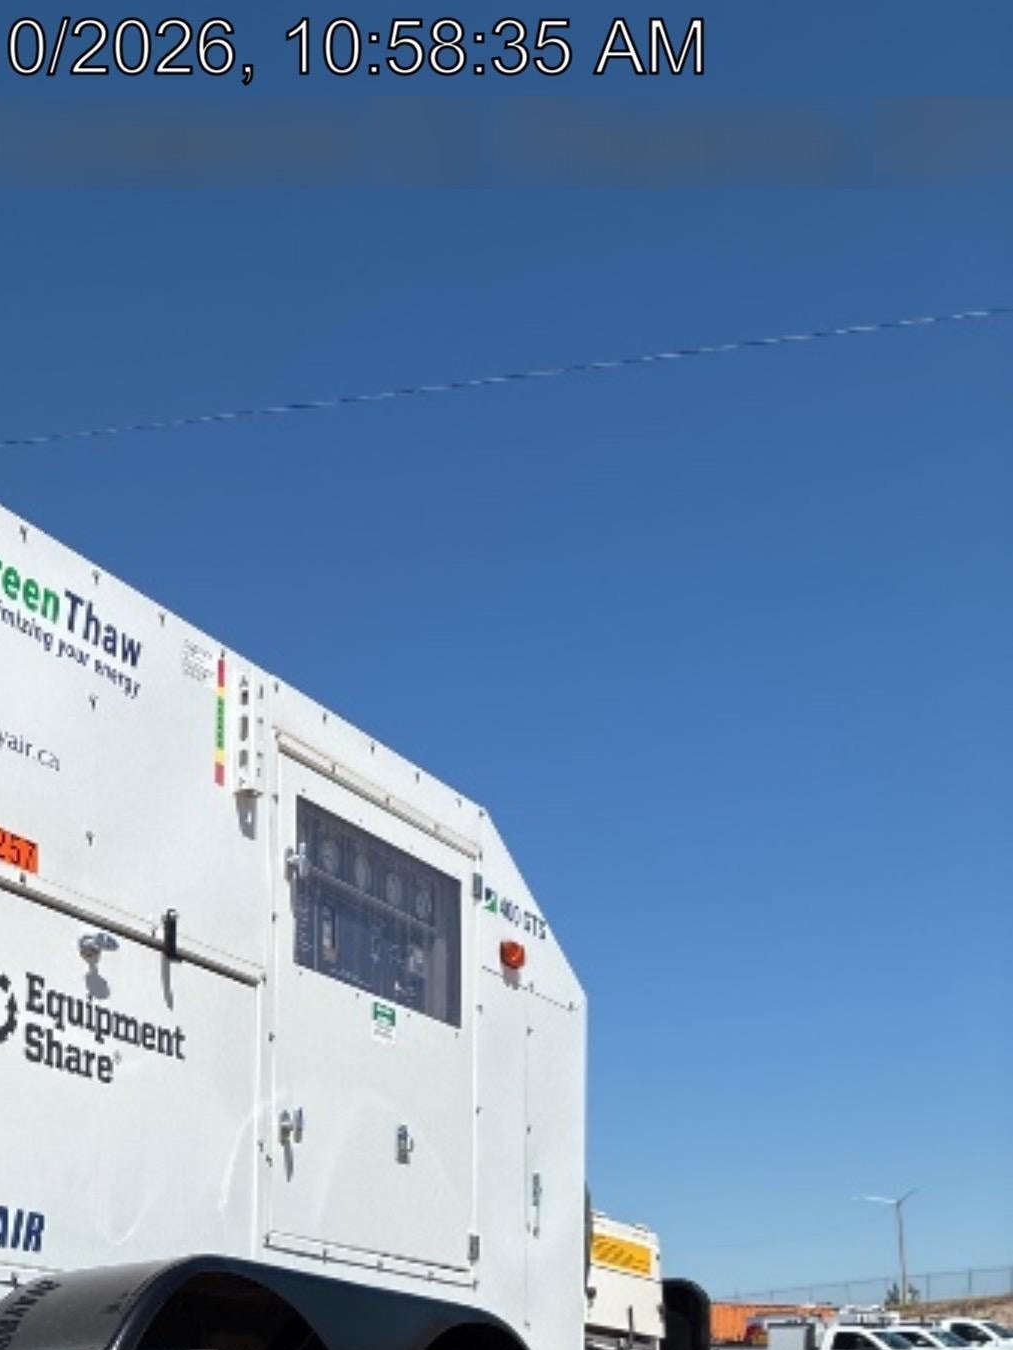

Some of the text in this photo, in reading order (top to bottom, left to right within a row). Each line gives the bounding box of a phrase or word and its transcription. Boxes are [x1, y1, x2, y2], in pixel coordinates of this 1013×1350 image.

[56, 639, 90, 666] your
[94, 659, 141, 699] energy
[24, 971, 186, 1060] Equipment
